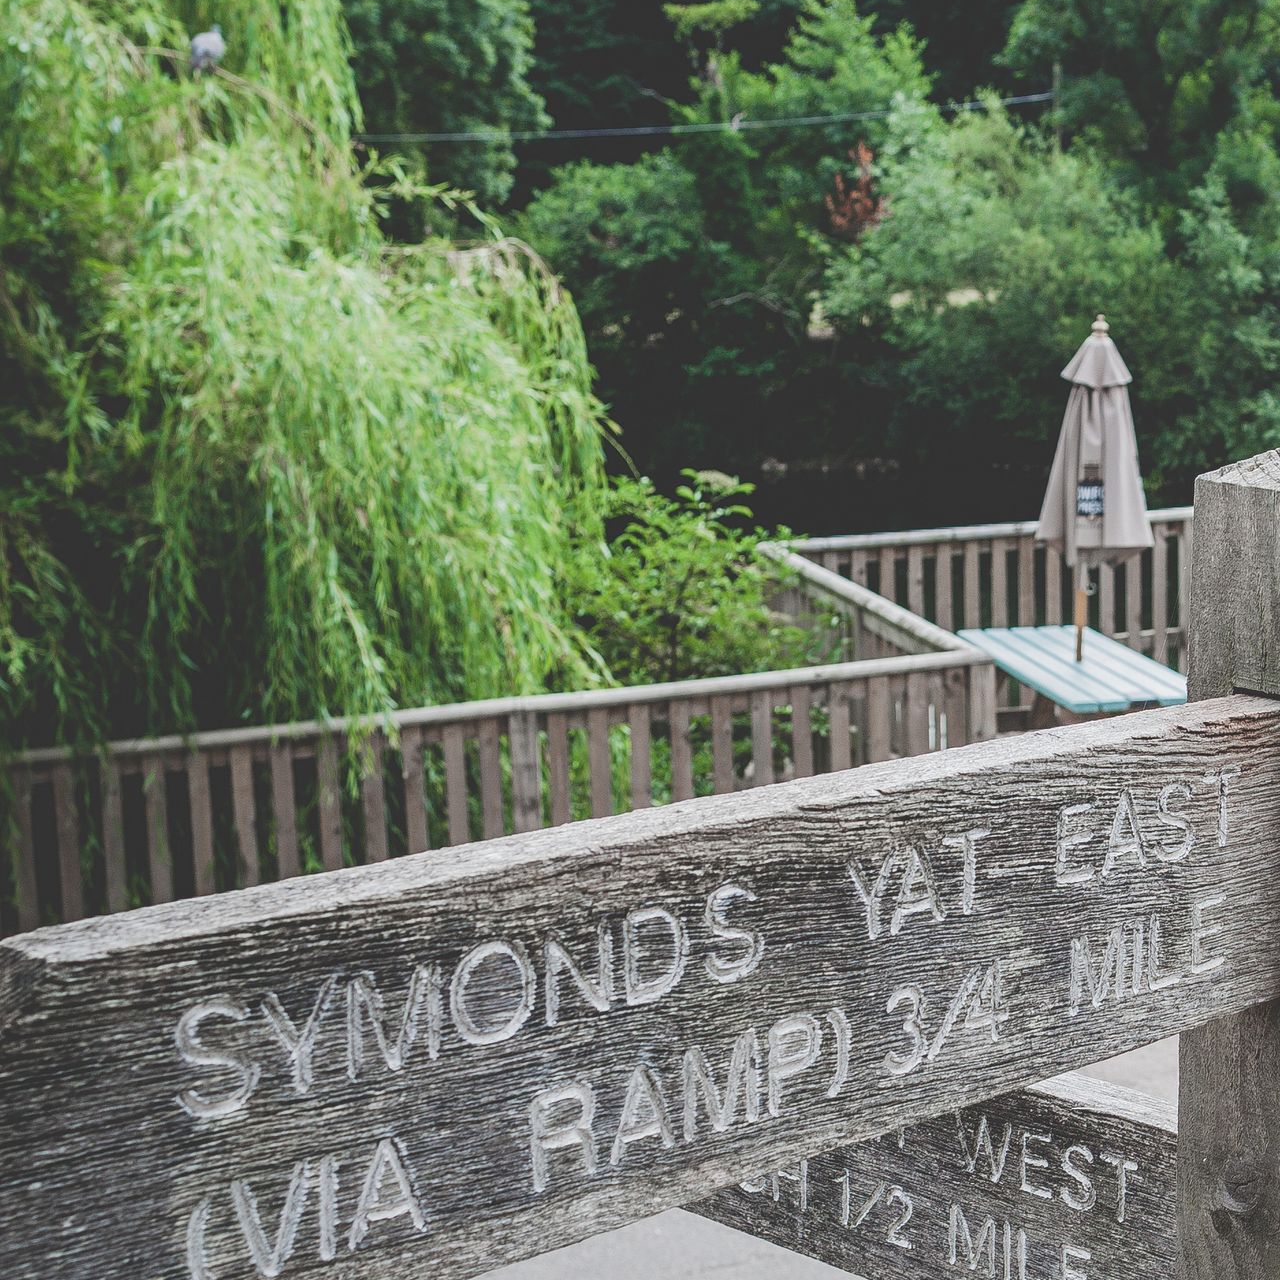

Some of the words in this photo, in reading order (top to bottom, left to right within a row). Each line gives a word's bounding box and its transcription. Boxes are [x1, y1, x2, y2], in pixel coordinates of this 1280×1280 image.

[174, 885, 765, 1120] SYMONDS
[847, 826, 991, 941] YAT
[1055, 766, 1242, 887] EAST
[530, 1005, 850, 1194] RAMP)
[883, 964, 1010, 1077] 3/4
[1069, 893, 1229, 1017] MILE
[833, 1167, 913, 1250] 1/2
[954, 1109, 1139, 1223] WEST
